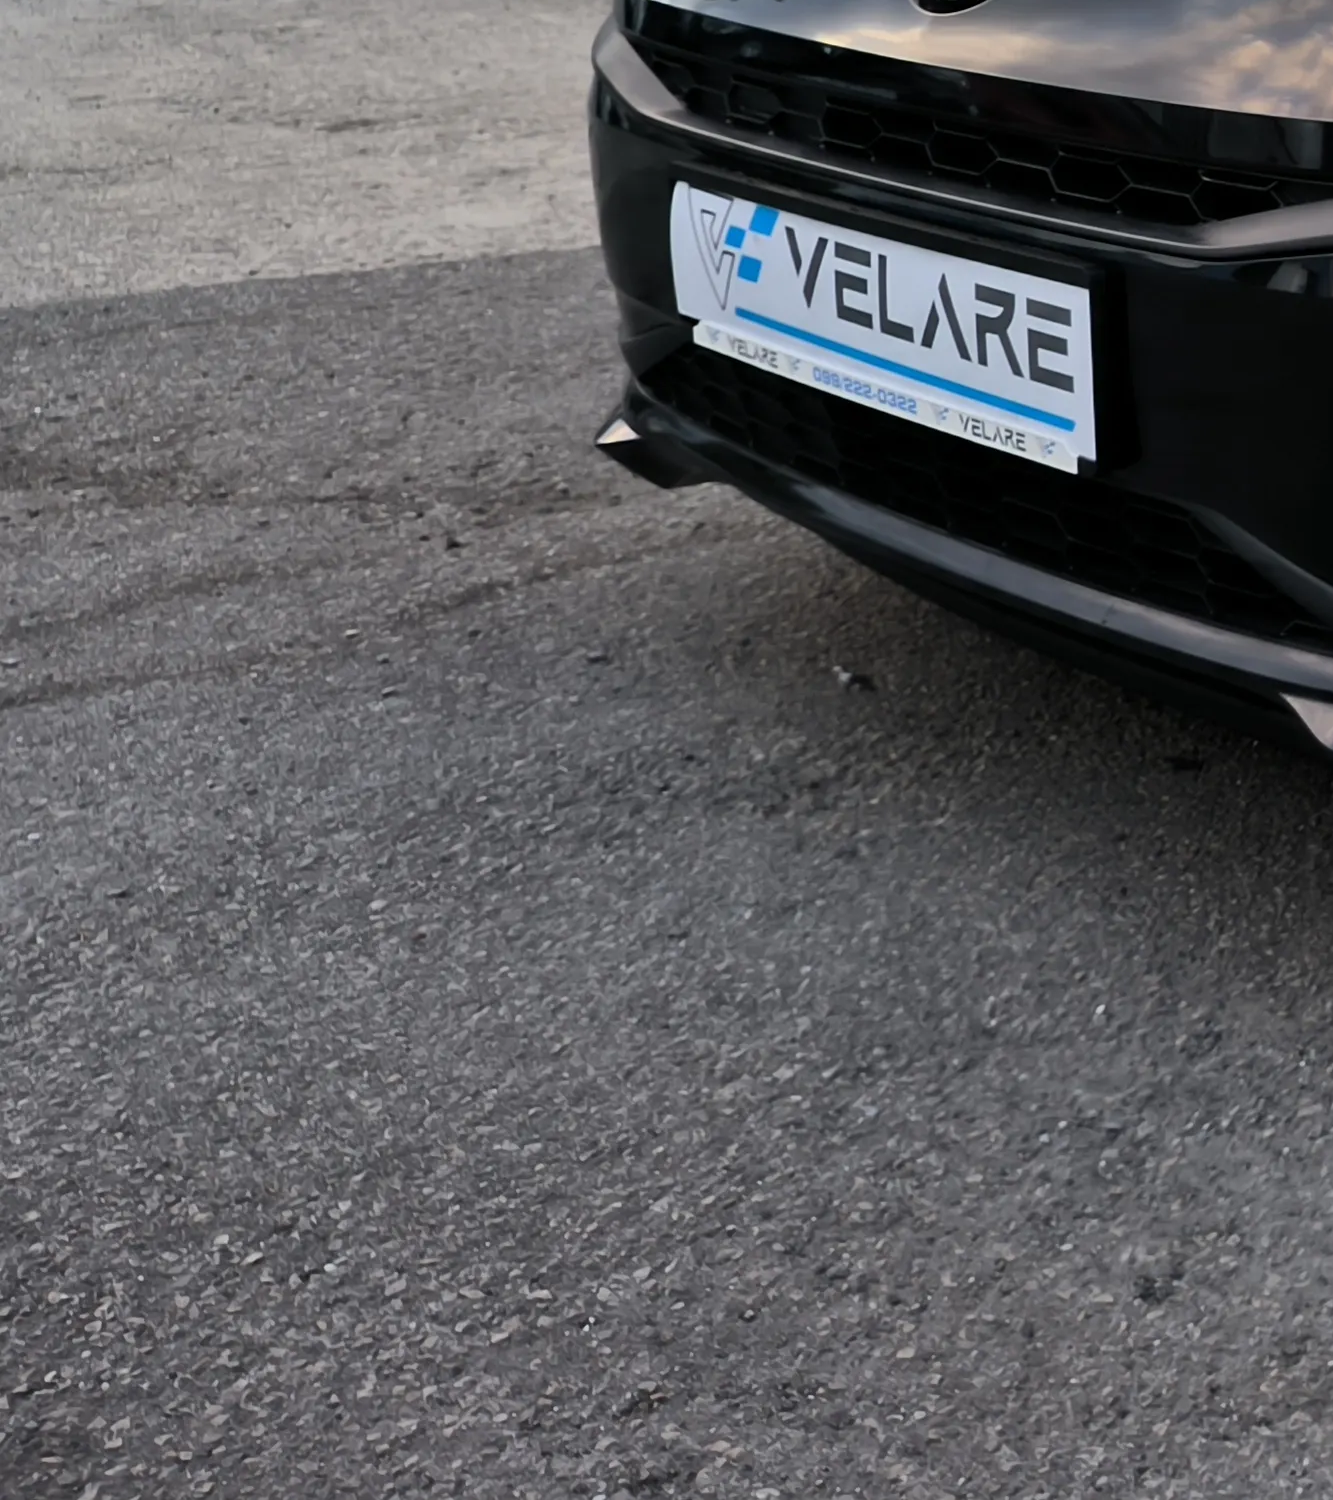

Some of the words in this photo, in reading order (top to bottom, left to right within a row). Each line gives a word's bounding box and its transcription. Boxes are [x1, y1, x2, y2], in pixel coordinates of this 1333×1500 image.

[785, 226, 1075, 393] VELARE
[726, 334, 779, 369] VELARE
[957, 412, 1028, 452] VELARE
